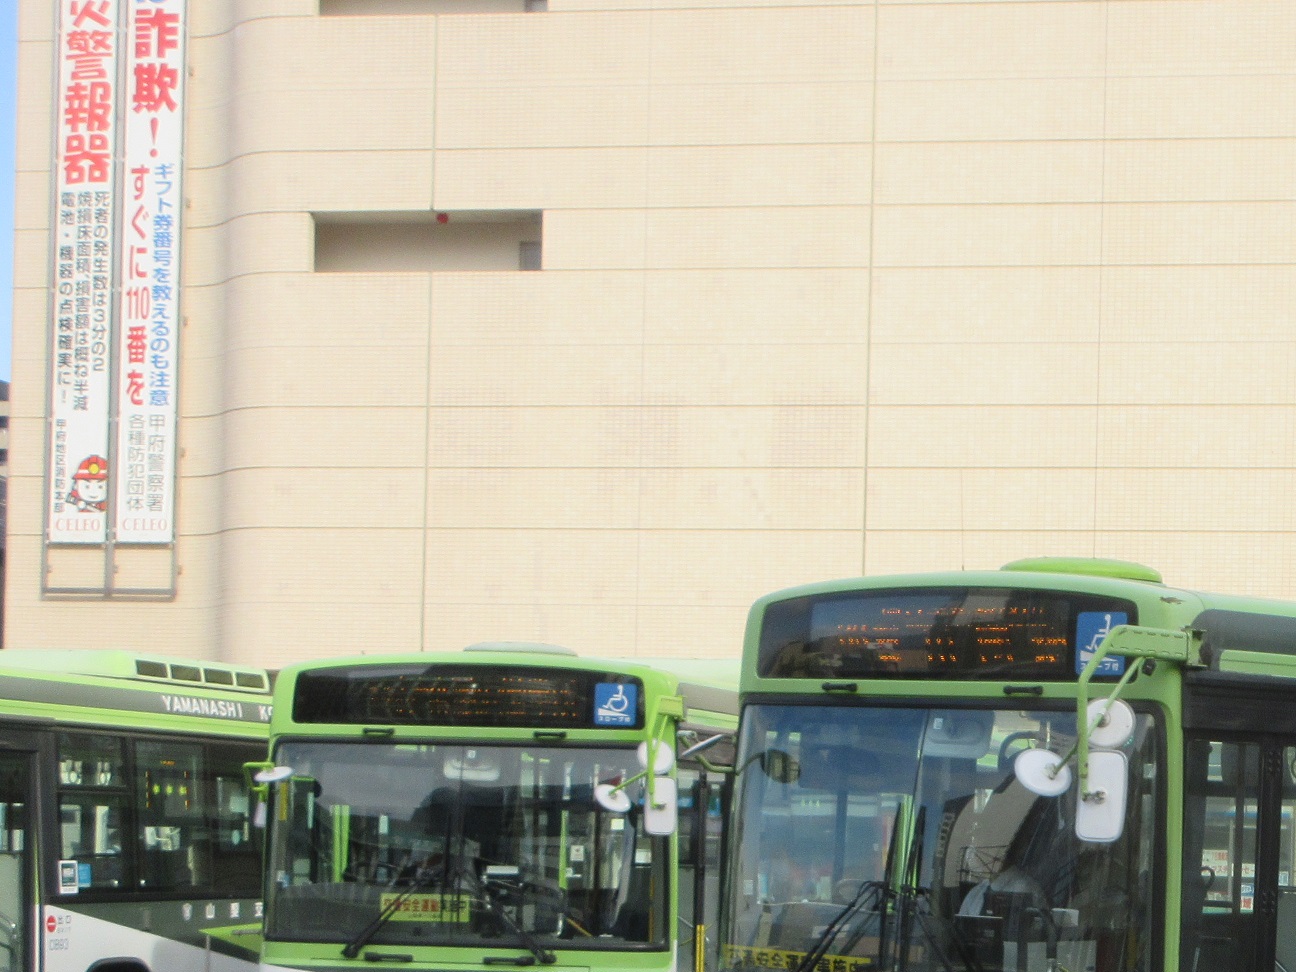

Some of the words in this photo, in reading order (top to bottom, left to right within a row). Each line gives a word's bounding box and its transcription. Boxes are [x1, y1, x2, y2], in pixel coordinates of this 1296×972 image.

[55, 518, 101, 532] CELEO
[122, 517, 168, 532] CELEO
[162, 694, 243, 718] YAMANASHI
